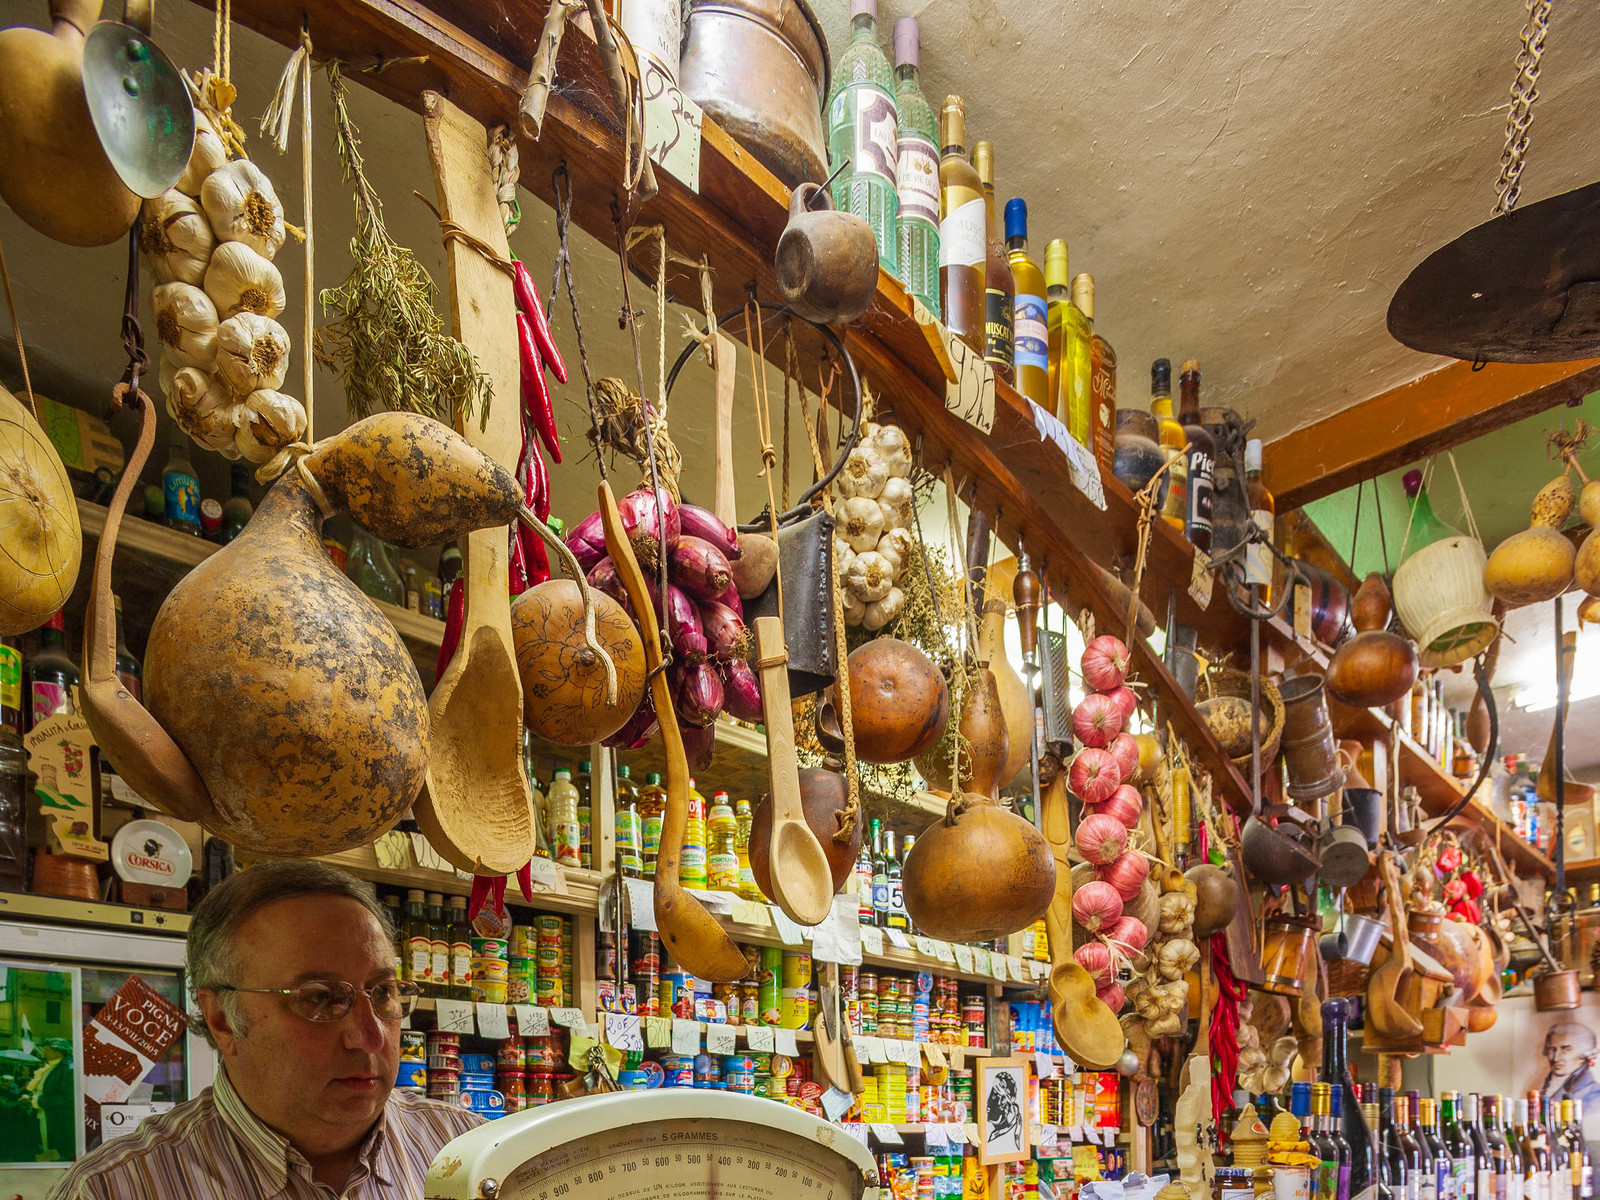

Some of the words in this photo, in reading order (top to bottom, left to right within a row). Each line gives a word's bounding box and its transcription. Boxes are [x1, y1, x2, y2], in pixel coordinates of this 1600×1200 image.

[986, 321, 1010, 338] MUSCAT
[128, 854, 171, 874] CORSICA
[114, 995, 172, 1047] VOCE
[142, 1000, 179, 1032] PIGNA
[608, 1138, 644, 1150] GRADUATION
[662, 1132, 668, 1142] 5
[670, 1132, 718, 1141] GRAMMES
[544, 1158, 570, 1172] MINIMUM
[538, 1191, 548, 1200] 50
[554, 1183, 570, 1198] 900
[574, 1176, 582, 1185] 50
[588, 1170, 604, 1184] 800
[608, 1166, 616, 1174] 50
[622, 1162, 637, 1172] 700
[642, 1158, 649, 1166] 50
[655, 1157, 670, 1167] 600
[674, 1154, 682, 1162] 50
[687, 1154, 701, 1164] 500
[706, 1154, 713, 1162] 50
[718, 1156, 732, 1166] 400
[736, 1156, 743, 1164] 50
[747, 1160, 760, 1170] 300
[764, 1162, 772, 1170] 50
[775, 1167, 788, 1178] 200
[791, 1170, 798, 1179] 50
[802, 1176, 813, 1188] 100
[827, 1190, 833, 1200] 0
[618, 1189, 640, 1198] DESSUS
[653, 1183, 663, 1191] UN
[739, 1184, 764, 1193] LECTURES
